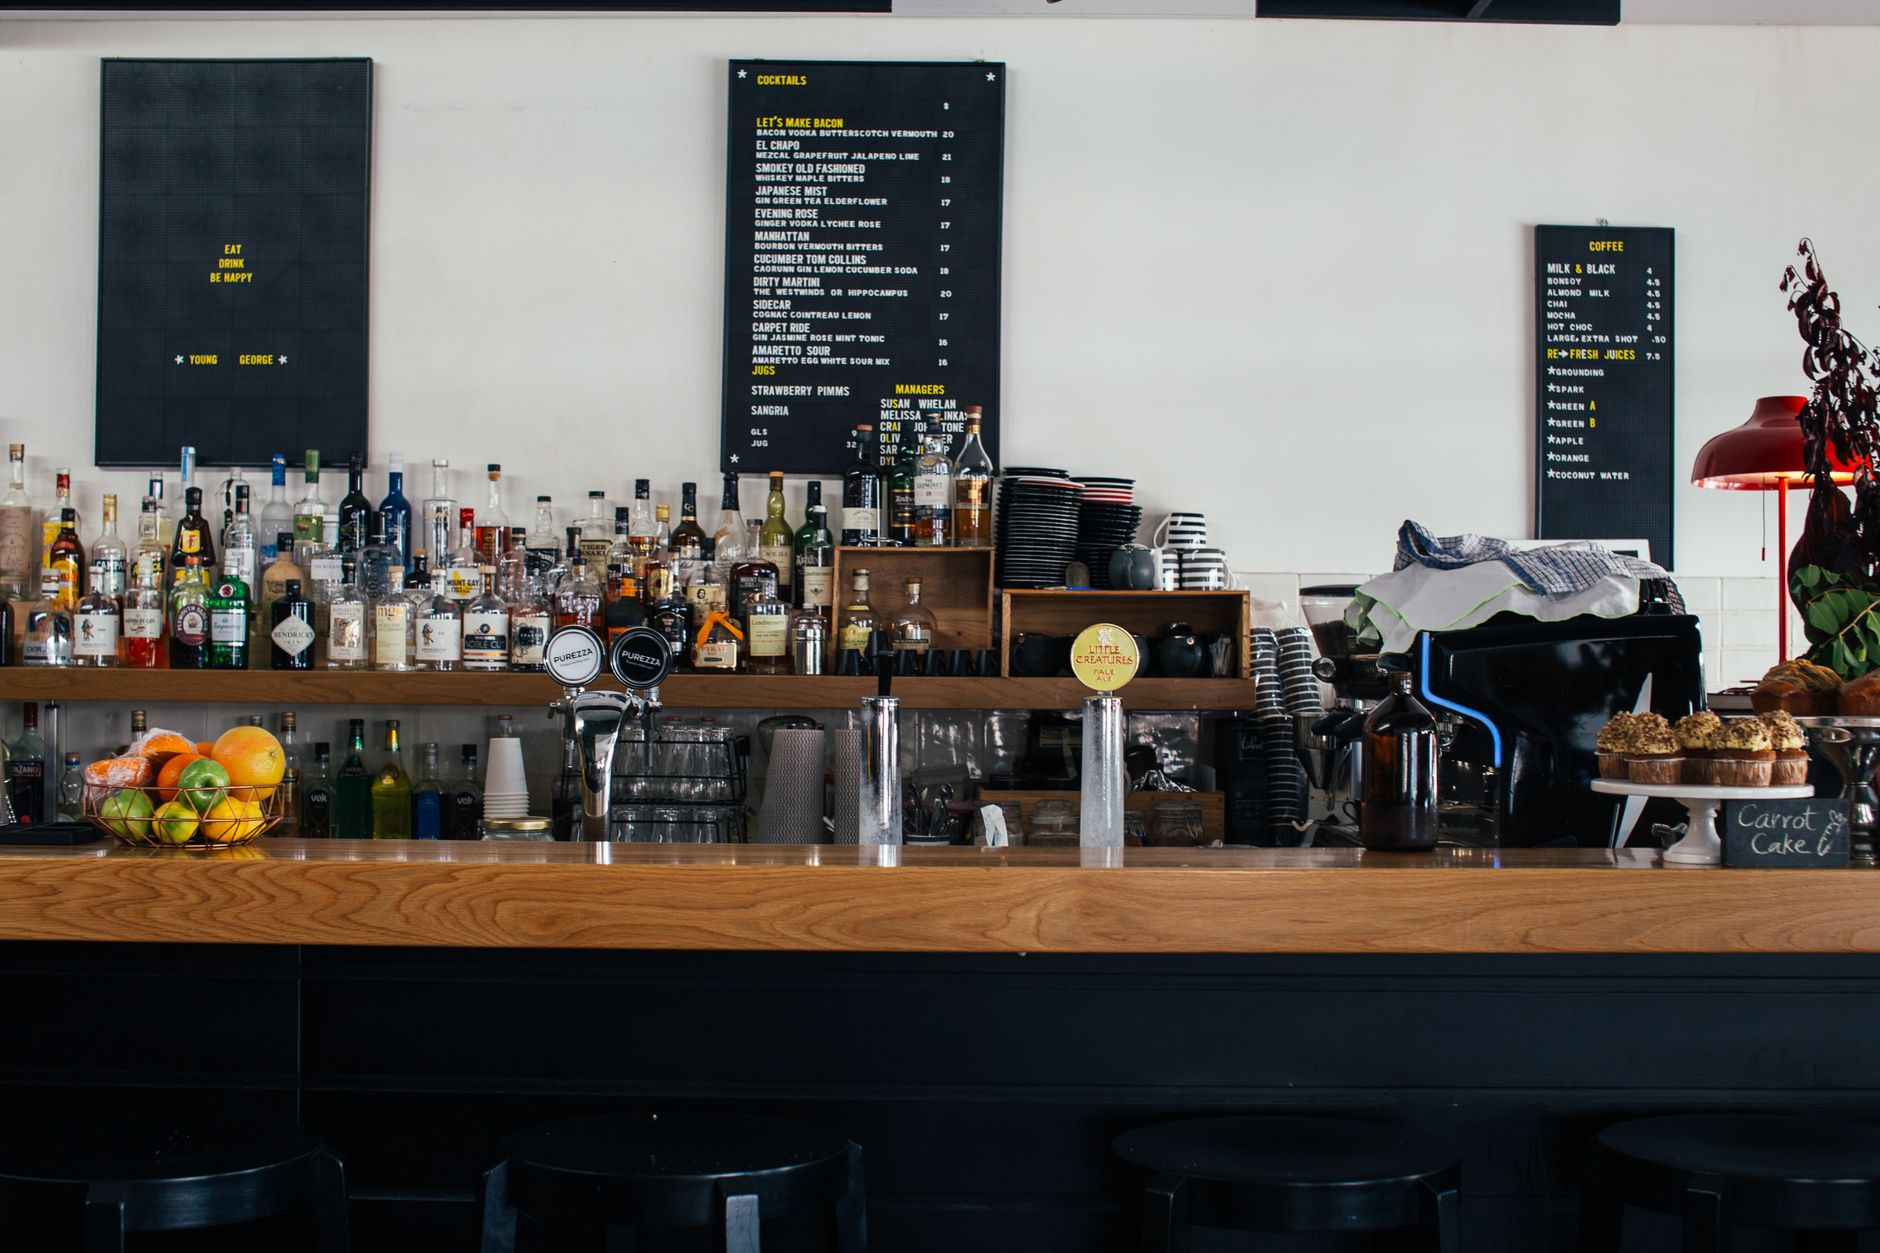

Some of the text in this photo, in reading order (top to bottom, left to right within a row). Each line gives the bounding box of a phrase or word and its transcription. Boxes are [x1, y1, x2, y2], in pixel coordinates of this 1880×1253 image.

[757, 75, 807, 86] COCKTAILS
[756, 115, 844, 129] LET'S MAKE BACON
[756, 128, 955, 139] BACON VODKA BUTTERSCOTCH VERMOUTH 20
[756, 139, 800, 151] EL CHAPO
[755, 151, 952, 161] MEZCAL GRAPEFRUIT JALAPENO LIME 21
[755, 162, 866, 175] SMOKEY OLD FASHIONED
[754, 174, 951, 184] WHISKEY MAPLE BITTERS 18
[754, 185, 828, 197] JAPANESE MIST
[754, 196, 951, 207] GIN GREEN TEA ELDERFLOWER 17
[754, 208, 819, 219] EVENING ROSE
[754, 219, 951, 230] GINGER VODKA LYCHEE ROSE 17
[754, 230, 810, 242] MANHATTAN
[224, 244, 242, 255] EAT
[754, 242, 951, 252] BOURBON VERMOUTH BITTERS 17
[1589, 240, 1624, 252] COFFEE
[218, 258, 245, 269] DRINK
[753, 253, 867, 265] CUCUMBER TOM COLLINS
[753, 264, 950, 275] CAORUNN GIN LEMON CUCUMBER SODA 18
[1547, 262, 1653, 275] MILK & BLACK 4
[209, 272, 253, 283] BE HAPPY
[753, 276, 821, 288] DIRTY MARTINI
[1546, 276, 1661, 287] BONSOY 4.5
[753, 287, 953, 298] THE WESTWINDS OR HIPPOCAMPUS 20
[1547, 288, 1661, 298] ALMOND MILK 4.5
[752, 299, 792, 310] SIDECAR
[1546, 299, 1661, 310] CHAI 4.5
[752, 310, 950, 321] COGNAC COINTREAU LEMON 17
[1546, 311, 1661, 321] MOCHA 4.5
[752, 322, 811, 334] CARPET RIDE
[1547, 322, 1653, 332] HOT CHOC 4
[752, 333, 949, 347] GIN JASMINE ROSE MINT TONIC 16
[1580, 334, 1610, 343] EXTRA
[1614, 334, 1639, 344] SHOT
[751, 344, 831, 357] AMARETTO SOUR
[1603, 349, 1636, 360] JUICES
[1645, 352, 1661, 361] 7.5
[189, 354, 274, 365] YOUNG GEORGE
[751, 356, 948, 367] AMARETTO EGG WHITE SOUR MIX 16
[751, 365, 776, 376] JUGS
[1555, 368, 1605, 377] GROUNDING
[751, 384, 850, 397] STRAWBERRY PIMMS
[895, 384, 945, 395] MANAGERS
[1555, 385, 1585, 394] SPARK
[880, 398, 957, 410] SUSAN WHELAN
[1555, 400, 1596, 411] GREEN A
[750, 405, 789, 416] SANGRIA
[880, 409, 922, 421] MELISSA
[879, 421, 901, 432] CRAI
[1555, 417, 1596, 428] GREEN B
[750, 428, 858, 437] GLS 9
[751, 439, 857, 449] JUG 32
[1555, 436, 1584, 446] APPLE
[1555, 454, 1590, 463] ORANGE
[1555, 471, 1630, 480] COCONUT WATER
[553, 648, 594, 663] PUREZZA
[1088, 645, 1121, 655] LITTLE
[621, 650, 661, 666] PUREZZA
[1075, 655, 1134, 665] CREATURES
[1737, 803, 1821, 831] Carrot
[1750, 832, 1813, 855] Cake
